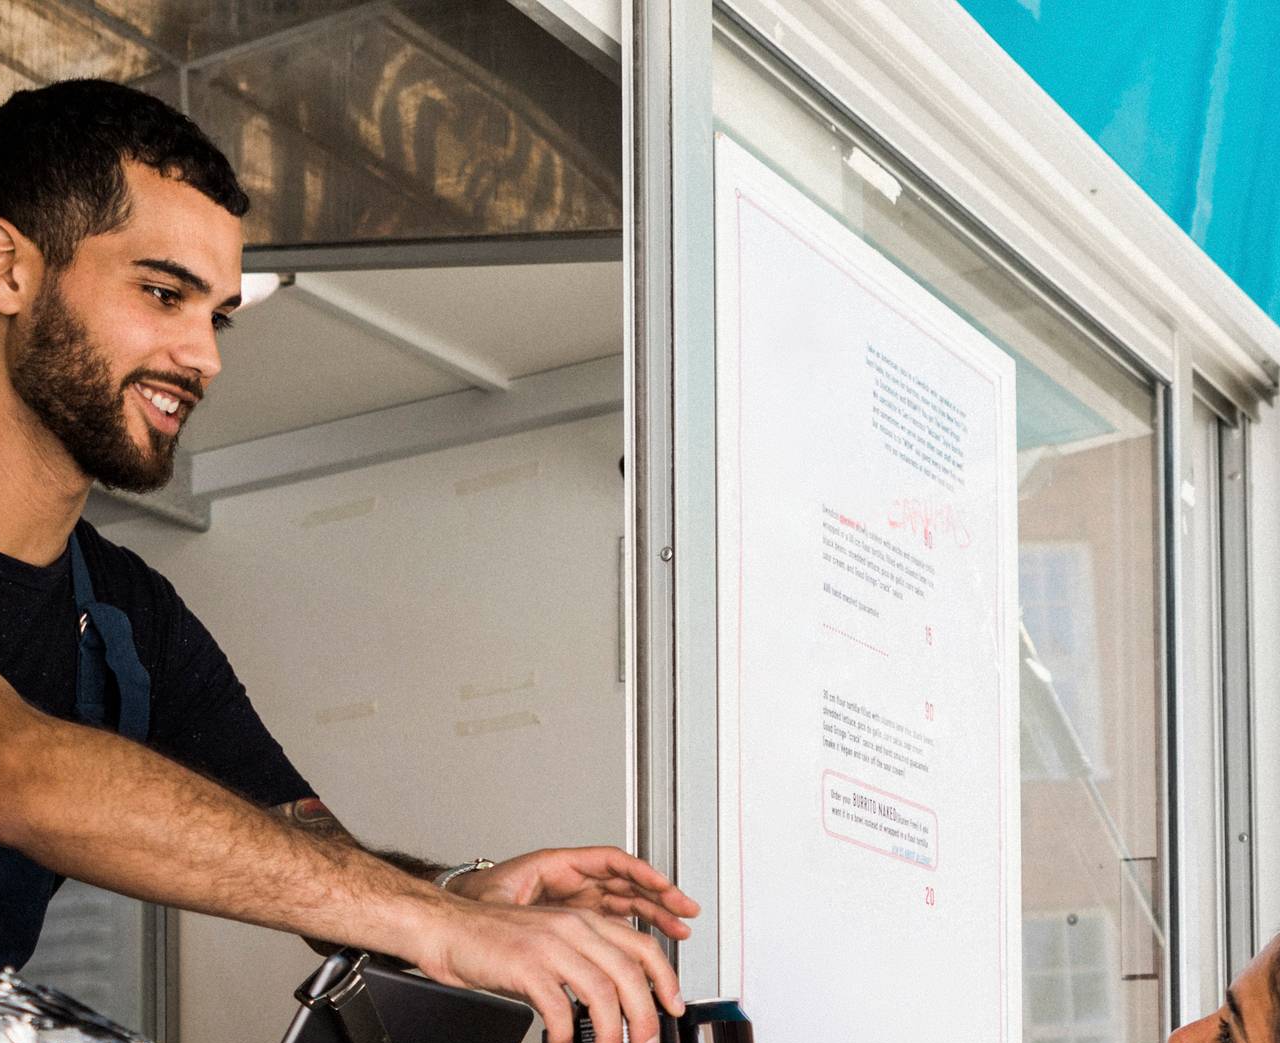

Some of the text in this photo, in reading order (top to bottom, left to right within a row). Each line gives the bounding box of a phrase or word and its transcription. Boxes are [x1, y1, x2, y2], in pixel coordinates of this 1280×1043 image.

[852, 792, 876, 814] BURRITO
[877, 802, 897, 821] NAKED
[924, 886, 935, 907] 20
